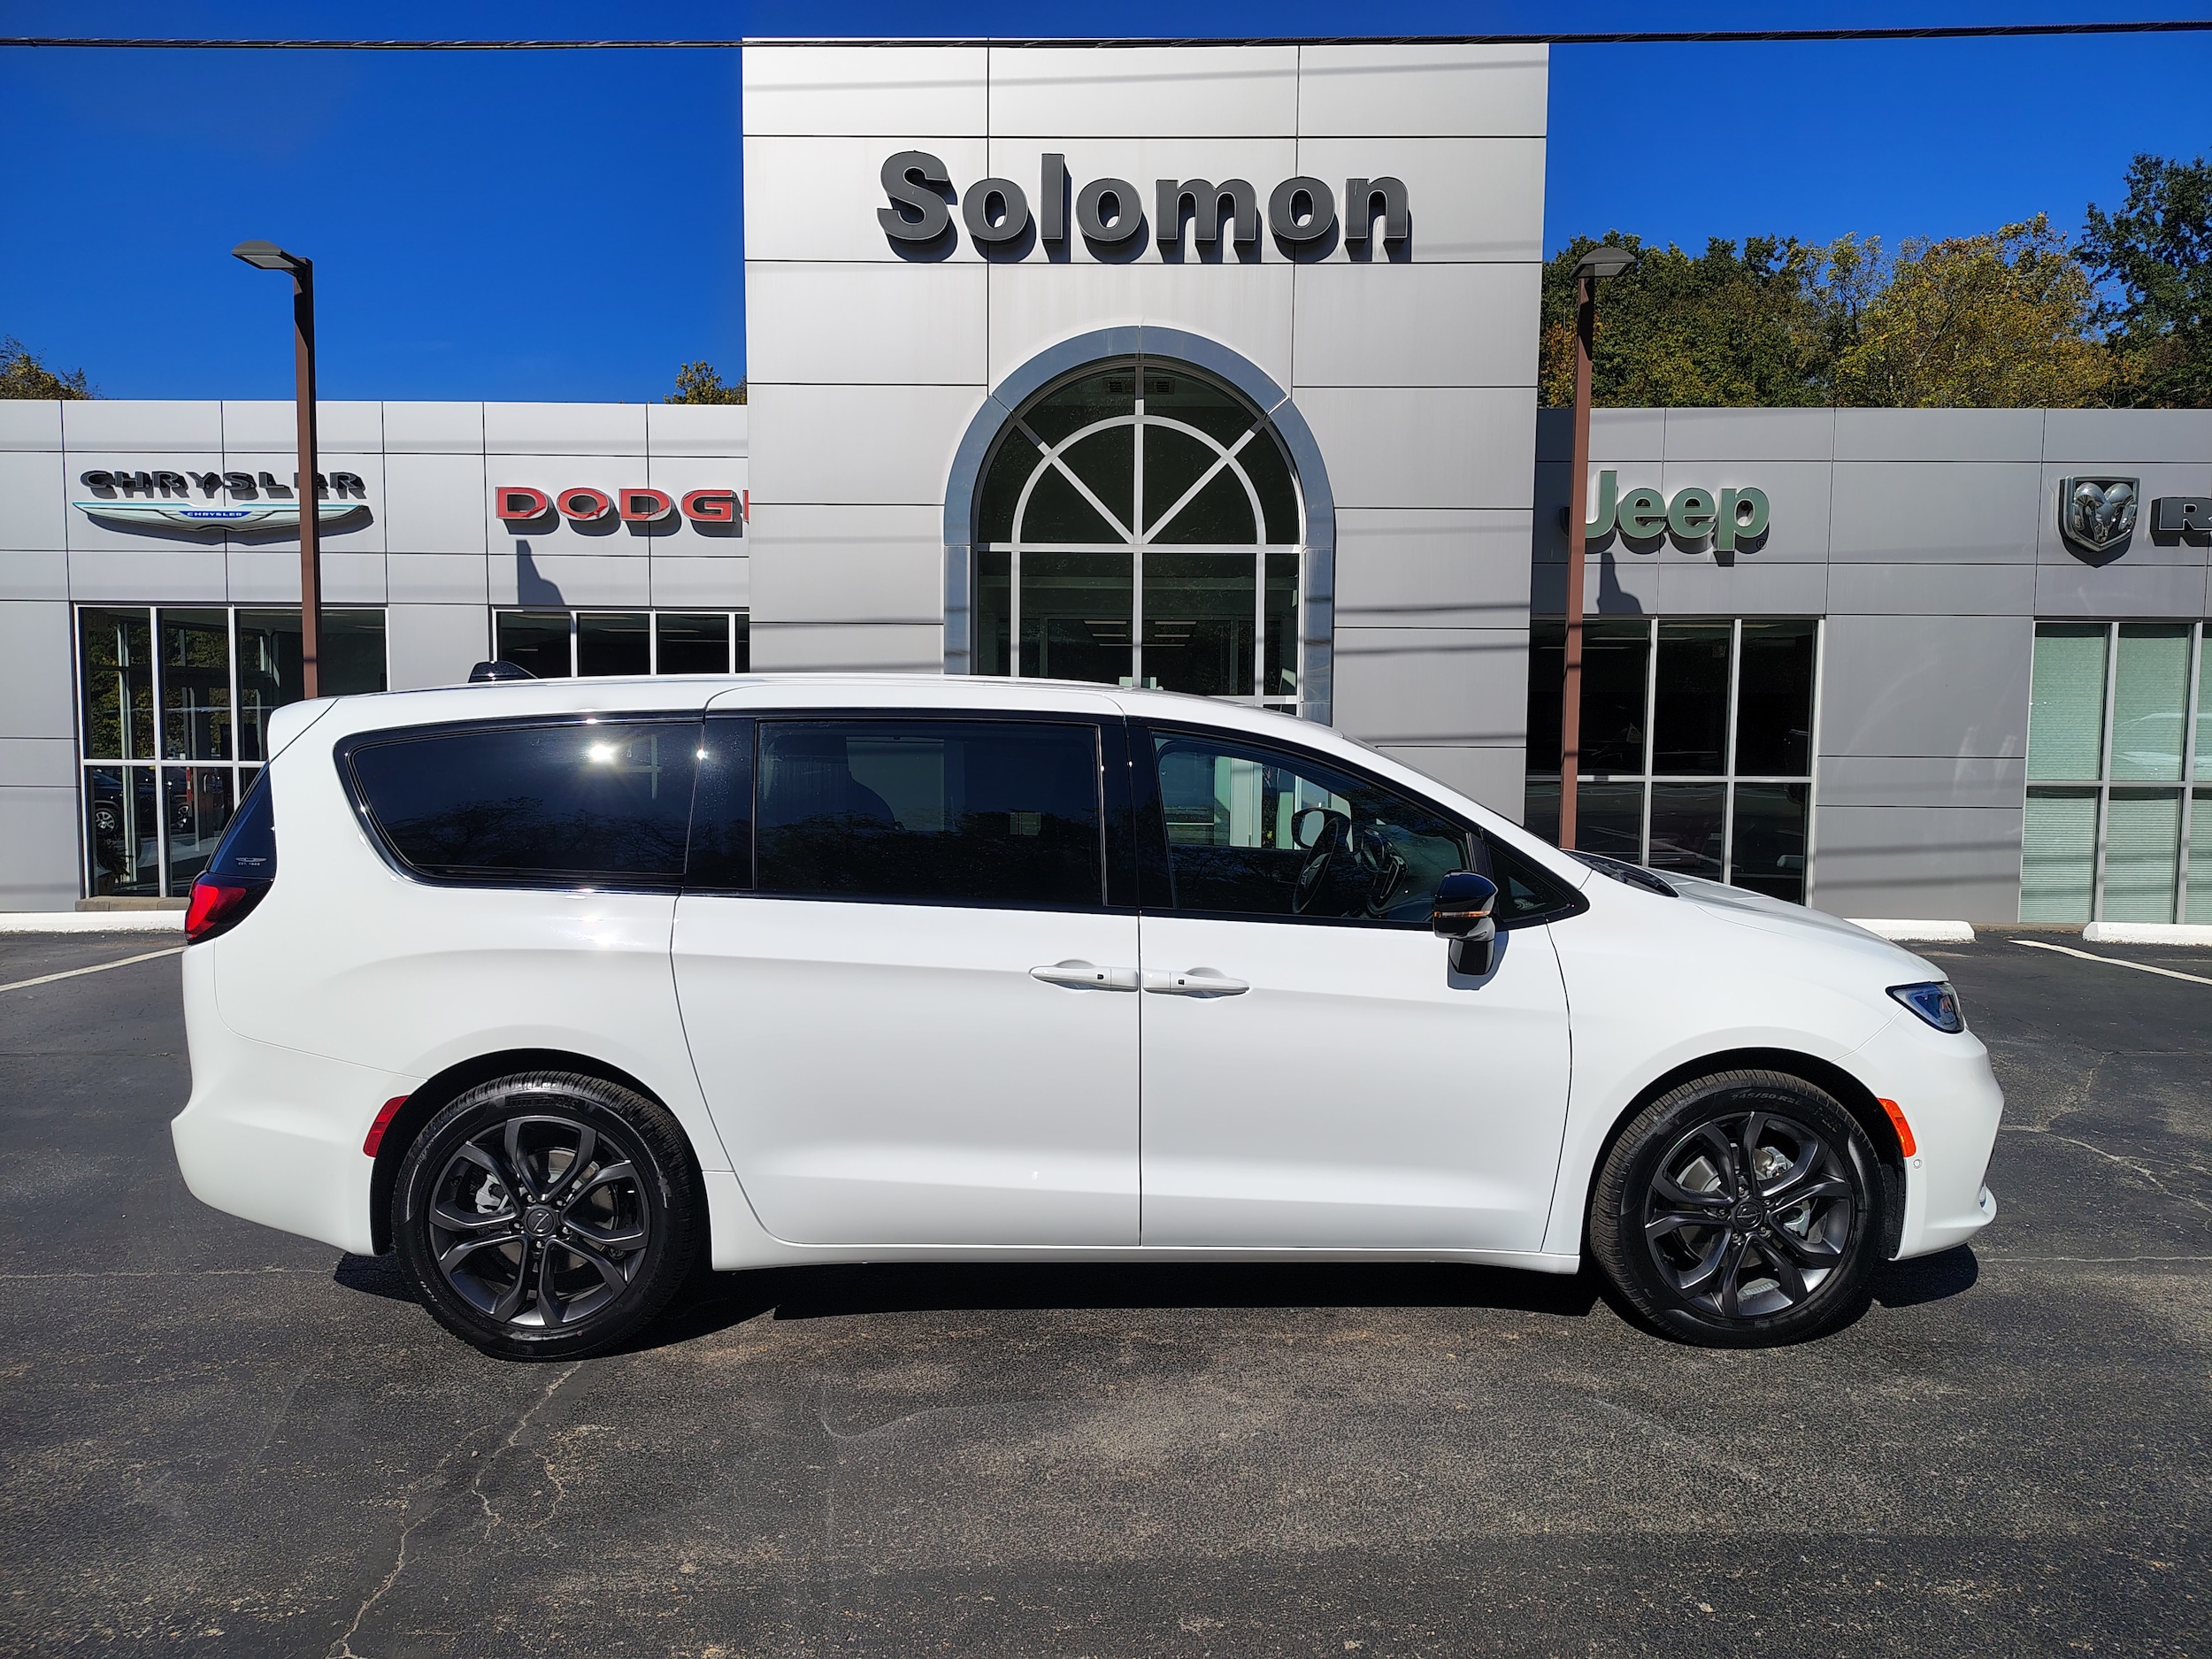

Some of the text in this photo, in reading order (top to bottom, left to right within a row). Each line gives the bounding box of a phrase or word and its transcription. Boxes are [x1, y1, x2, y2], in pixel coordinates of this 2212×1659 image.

[876, 150, 1409, 242] Solomon
[495, 487, 749, 522] DODG
[1586, 470, 1770, 551] Jeep
